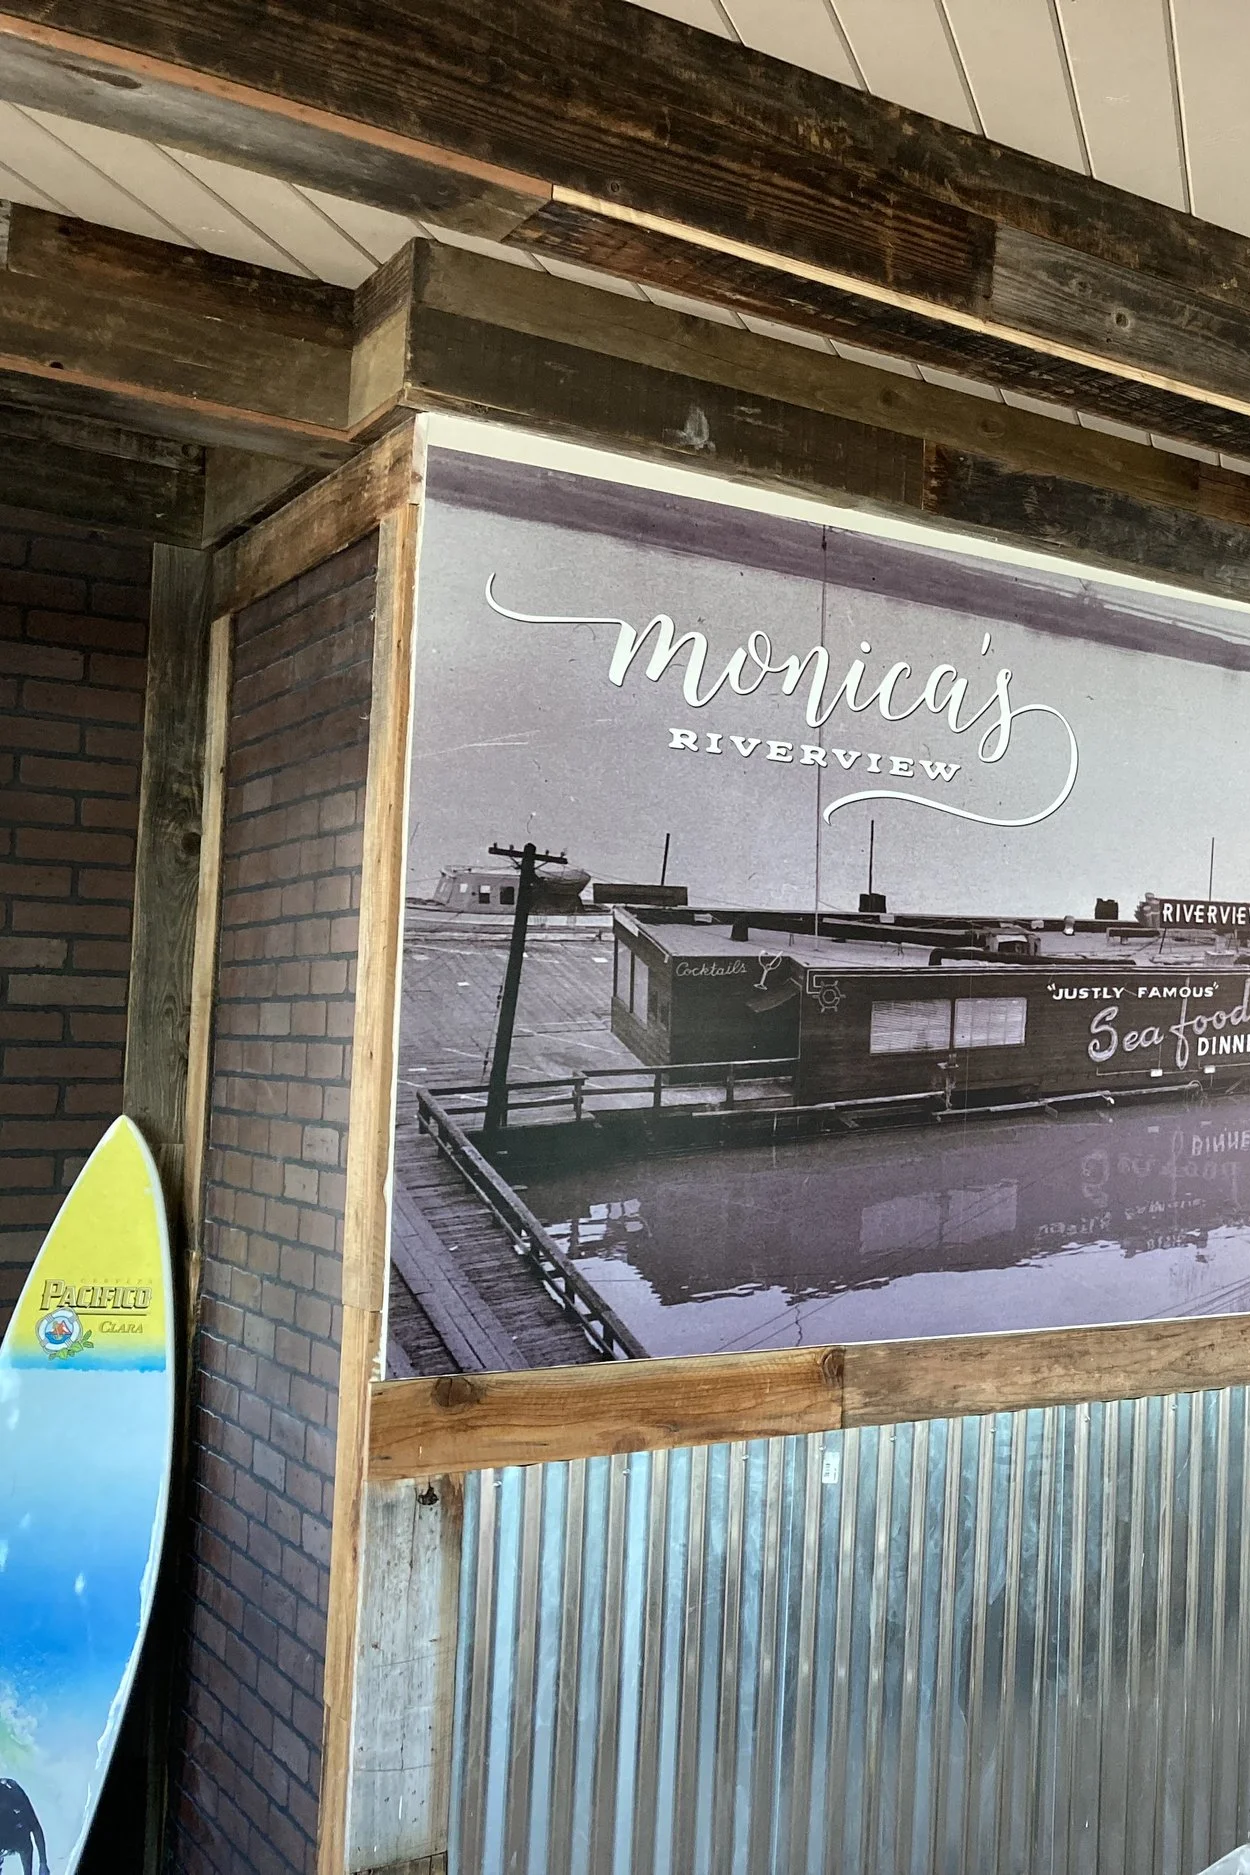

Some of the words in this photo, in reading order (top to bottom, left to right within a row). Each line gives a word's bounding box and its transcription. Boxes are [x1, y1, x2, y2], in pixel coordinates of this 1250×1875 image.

[485, 573, 1078, 765] Monica's
[667, 727, 962, 783] RIVERVIEW
[675, 959, 748, 978] Cocktails
[1087, 1005, 1165, 1063] Sea
[39, 1278, 153, 1311] PACIFICO
